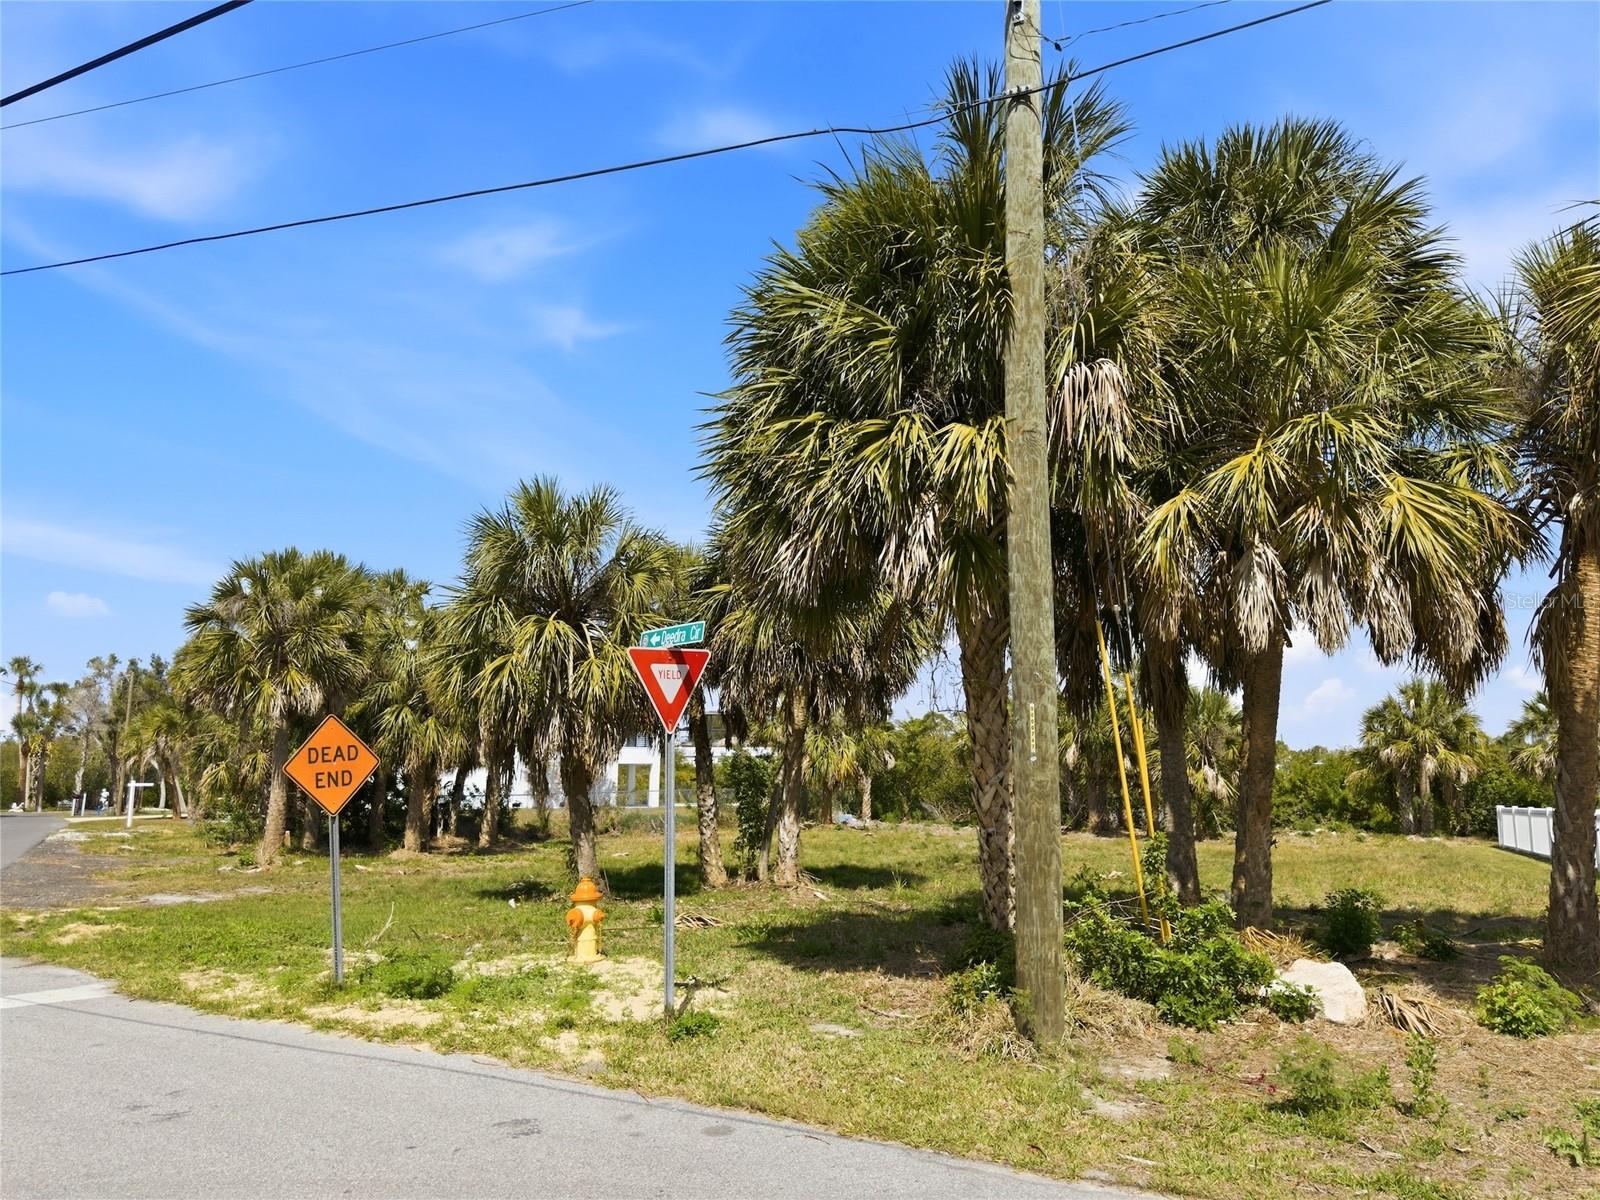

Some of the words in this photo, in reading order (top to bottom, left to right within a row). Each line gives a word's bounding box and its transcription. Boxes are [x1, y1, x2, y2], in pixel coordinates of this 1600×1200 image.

[660, 628, 686, 645] Deedra
[690, 624, 701, 641] Cir
[658, 669, 682, 680] YIELD
[307, 744, 359, 764] DEAD
[315, 769, 353, 789] END
